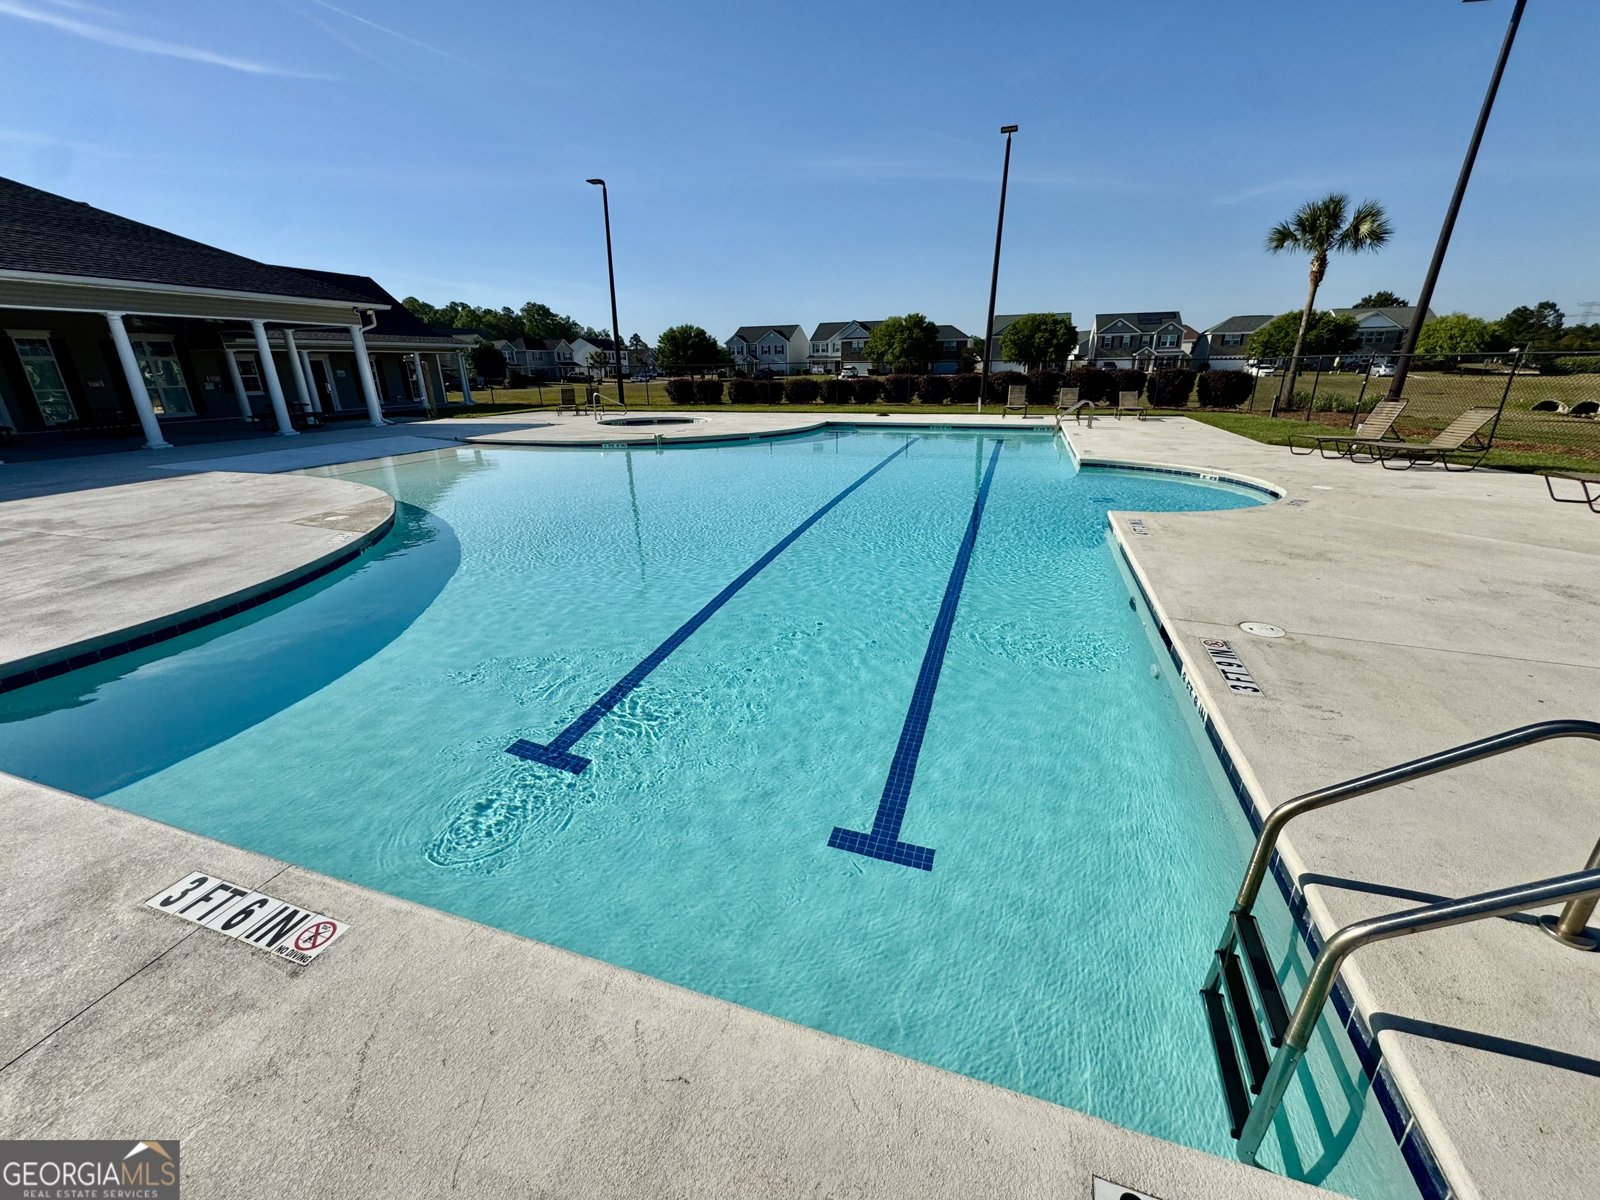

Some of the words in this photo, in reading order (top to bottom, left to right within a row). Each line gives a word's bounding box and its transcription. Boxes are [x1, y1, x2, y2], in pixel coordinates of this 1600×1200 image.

[1207, 648, 1238, 660] IN
[1221, 669, 1255, 684] FT
[1230, 684, 1260, 693] 3
[159, 876, 209, 907] 3
[178, 883, 249, 921] FT
[220, 898, 270, 931] 6
[244, 906, 311, 948] IN
[274, 944, 290, 955] NO
[285, 949, 312, 963] DIVING
